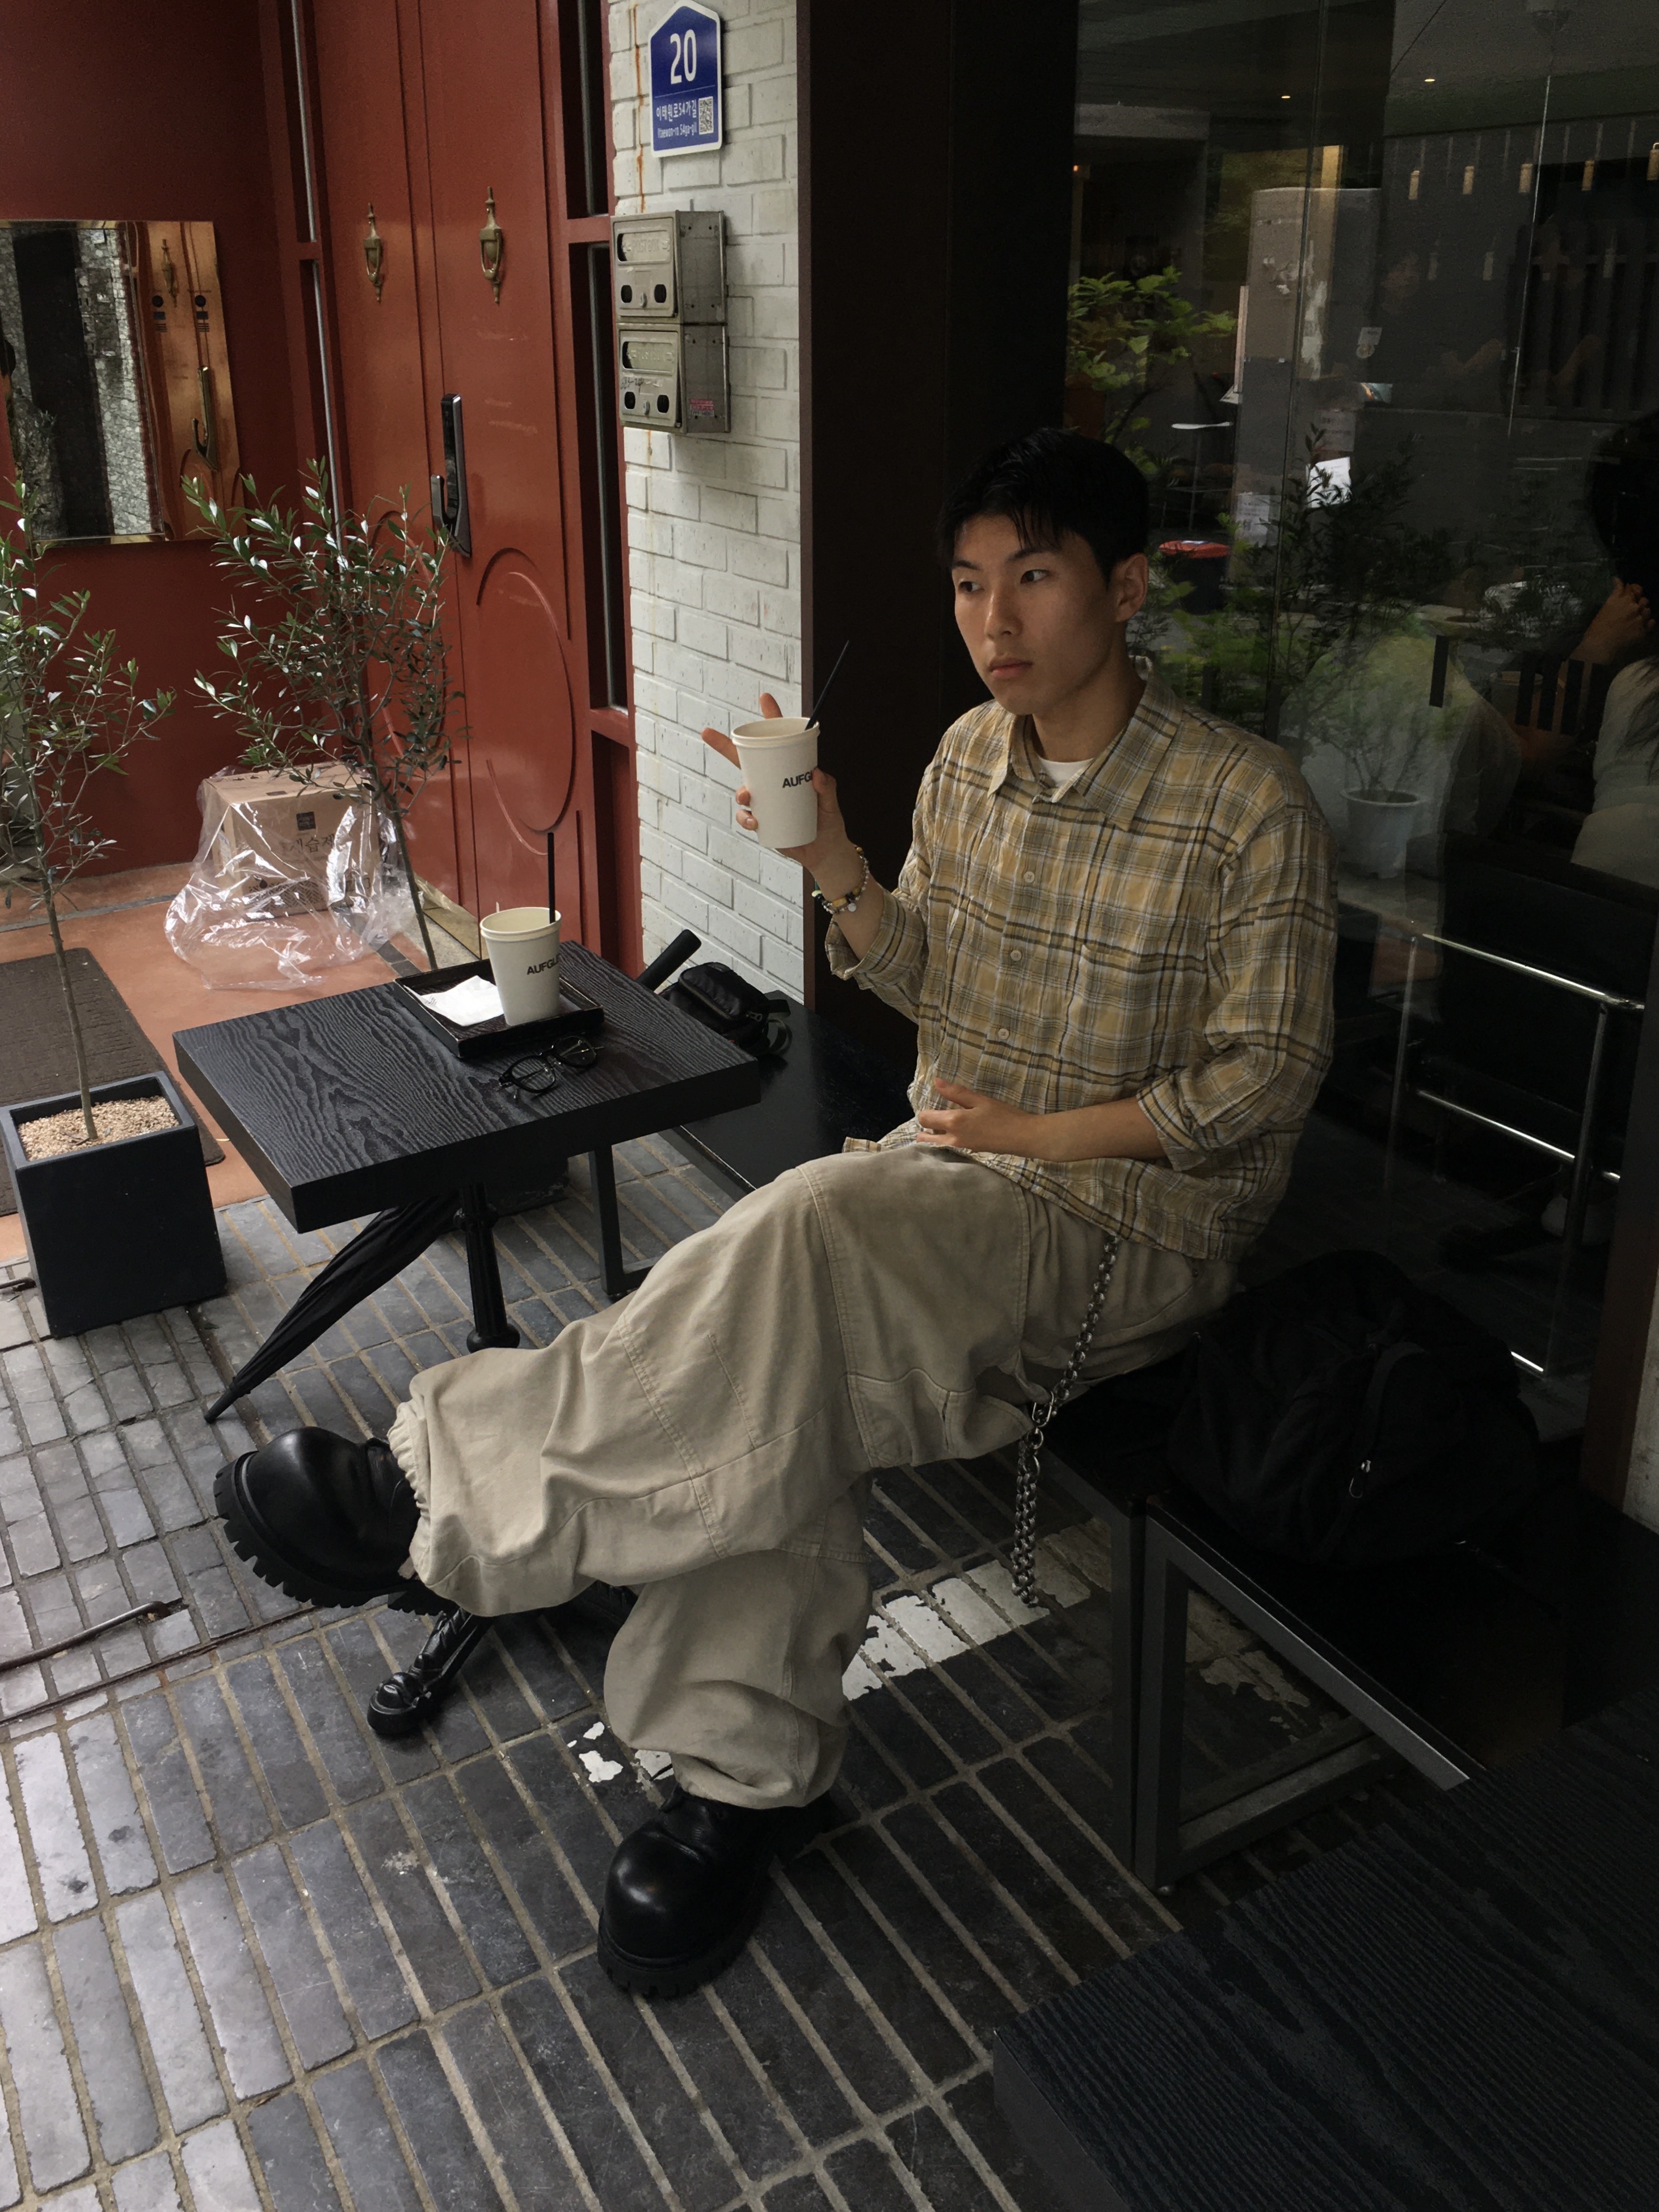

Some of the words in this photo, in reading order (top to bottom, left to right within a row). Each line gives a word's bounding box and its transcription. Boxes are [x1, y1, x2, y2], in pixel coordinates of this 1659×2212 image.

[670, 29, 697, 85] 20
[656, 99, 697, 122] 이태원로54가길
[680, 122, 697, 137] 54ga-gil
